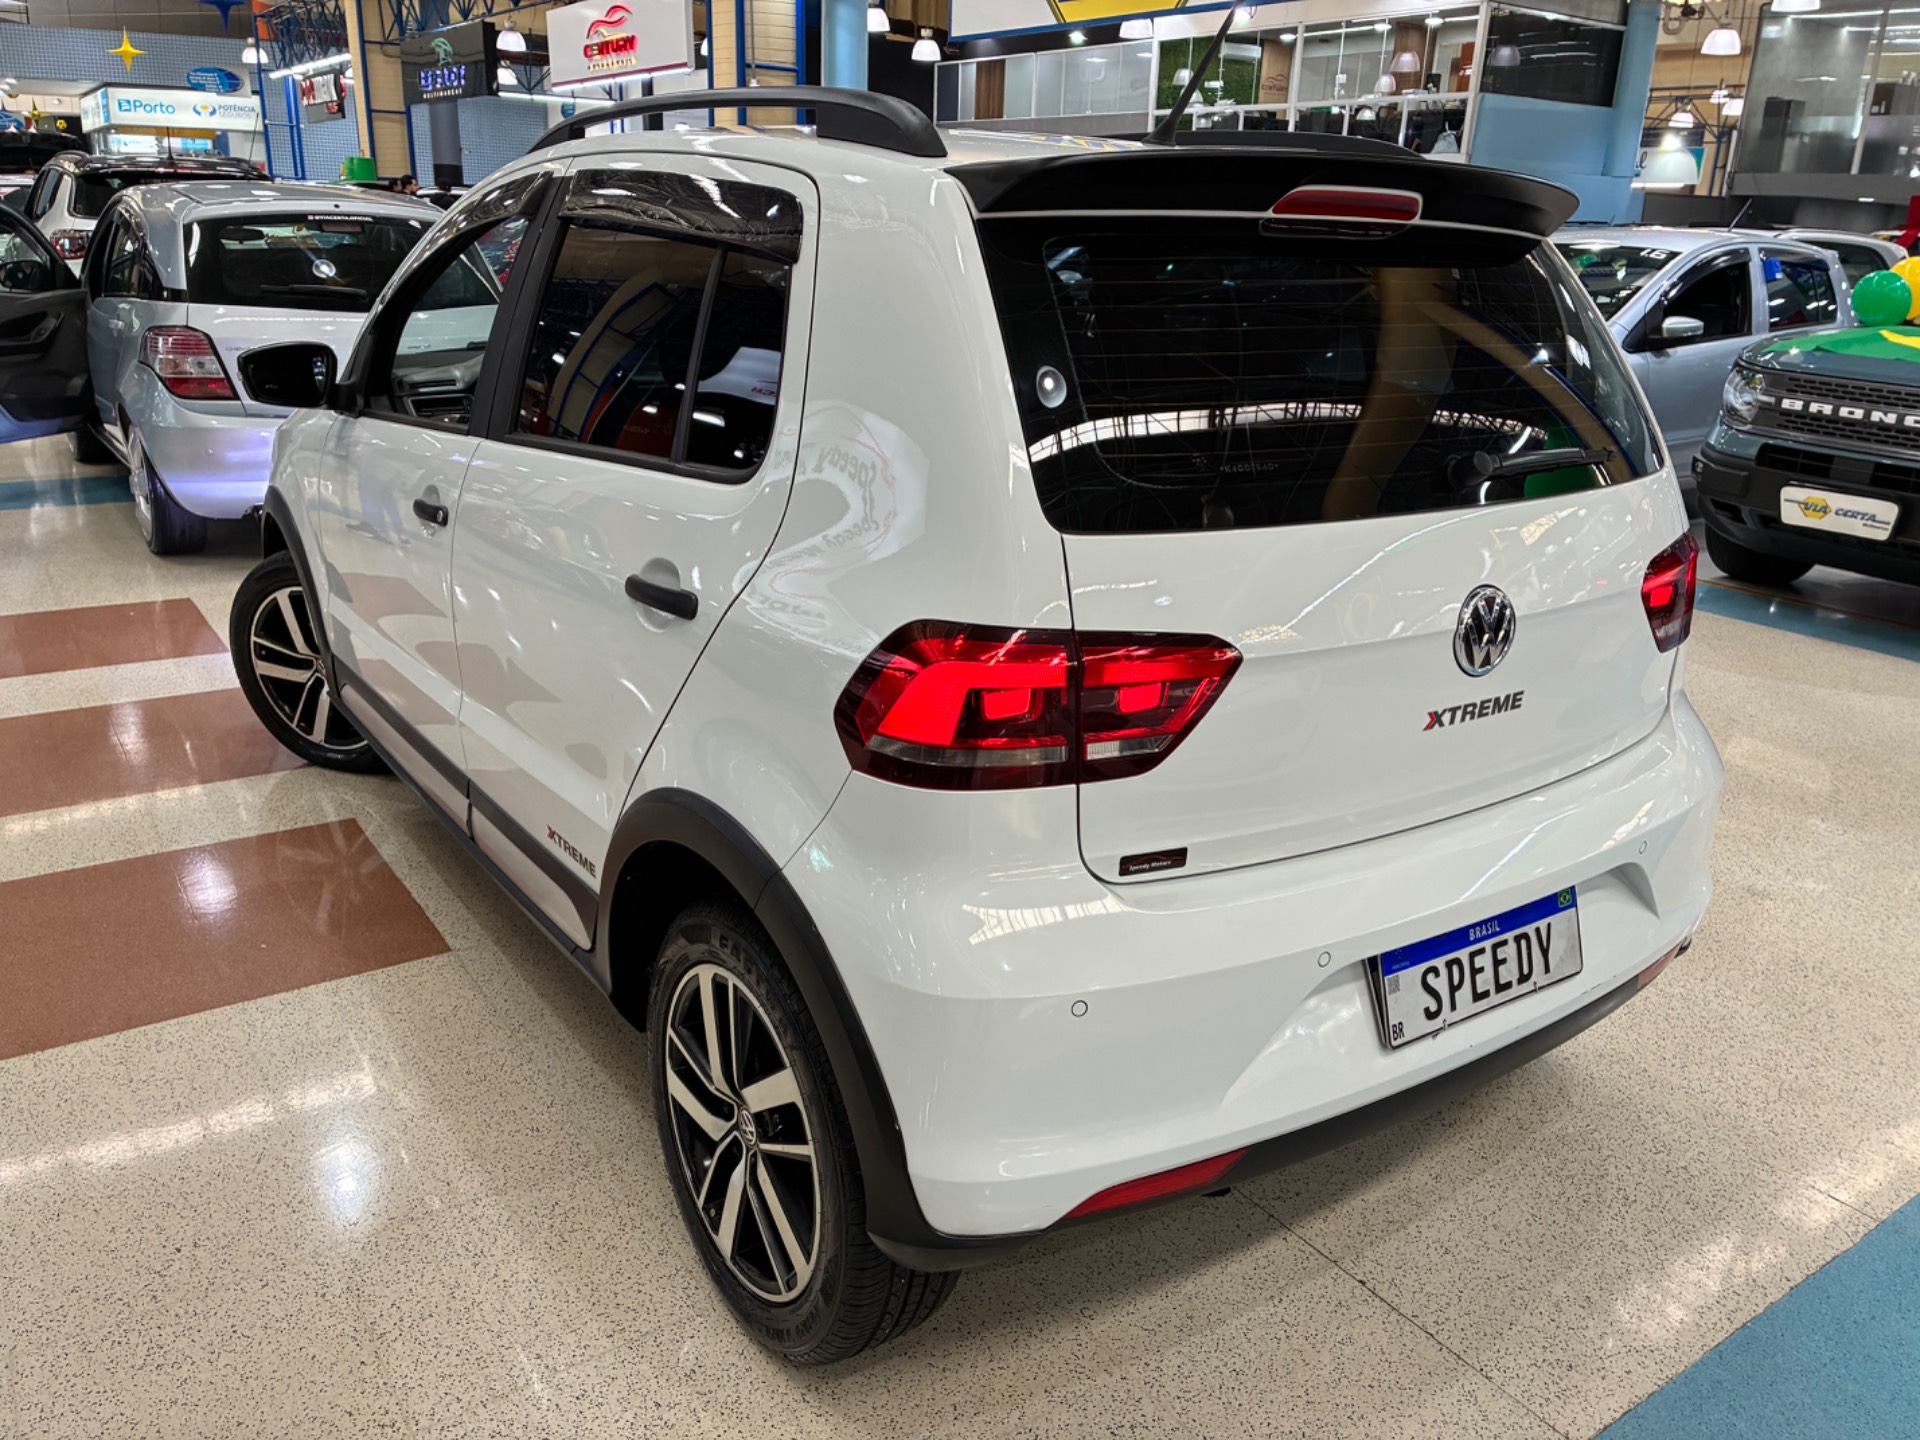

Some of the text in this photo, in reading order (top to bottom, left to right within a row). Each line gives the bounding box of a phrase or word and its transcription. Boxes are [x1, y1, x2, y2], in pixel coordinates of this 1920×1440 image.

[583, 34, 638, 60] CENTURY
[133, 99, 176, 115] Porto
[1804, 501, 1877, 523] VIA CERTA
[1422, 690, 1525, 732] XTREME
[546, 824, 596, 879] XTREME
[1469, 920, 1500, 941] BRASIL
[1420, 922, 1552, 1021] SPEEDY
[1391, 1021, 1405, 1041] BR
